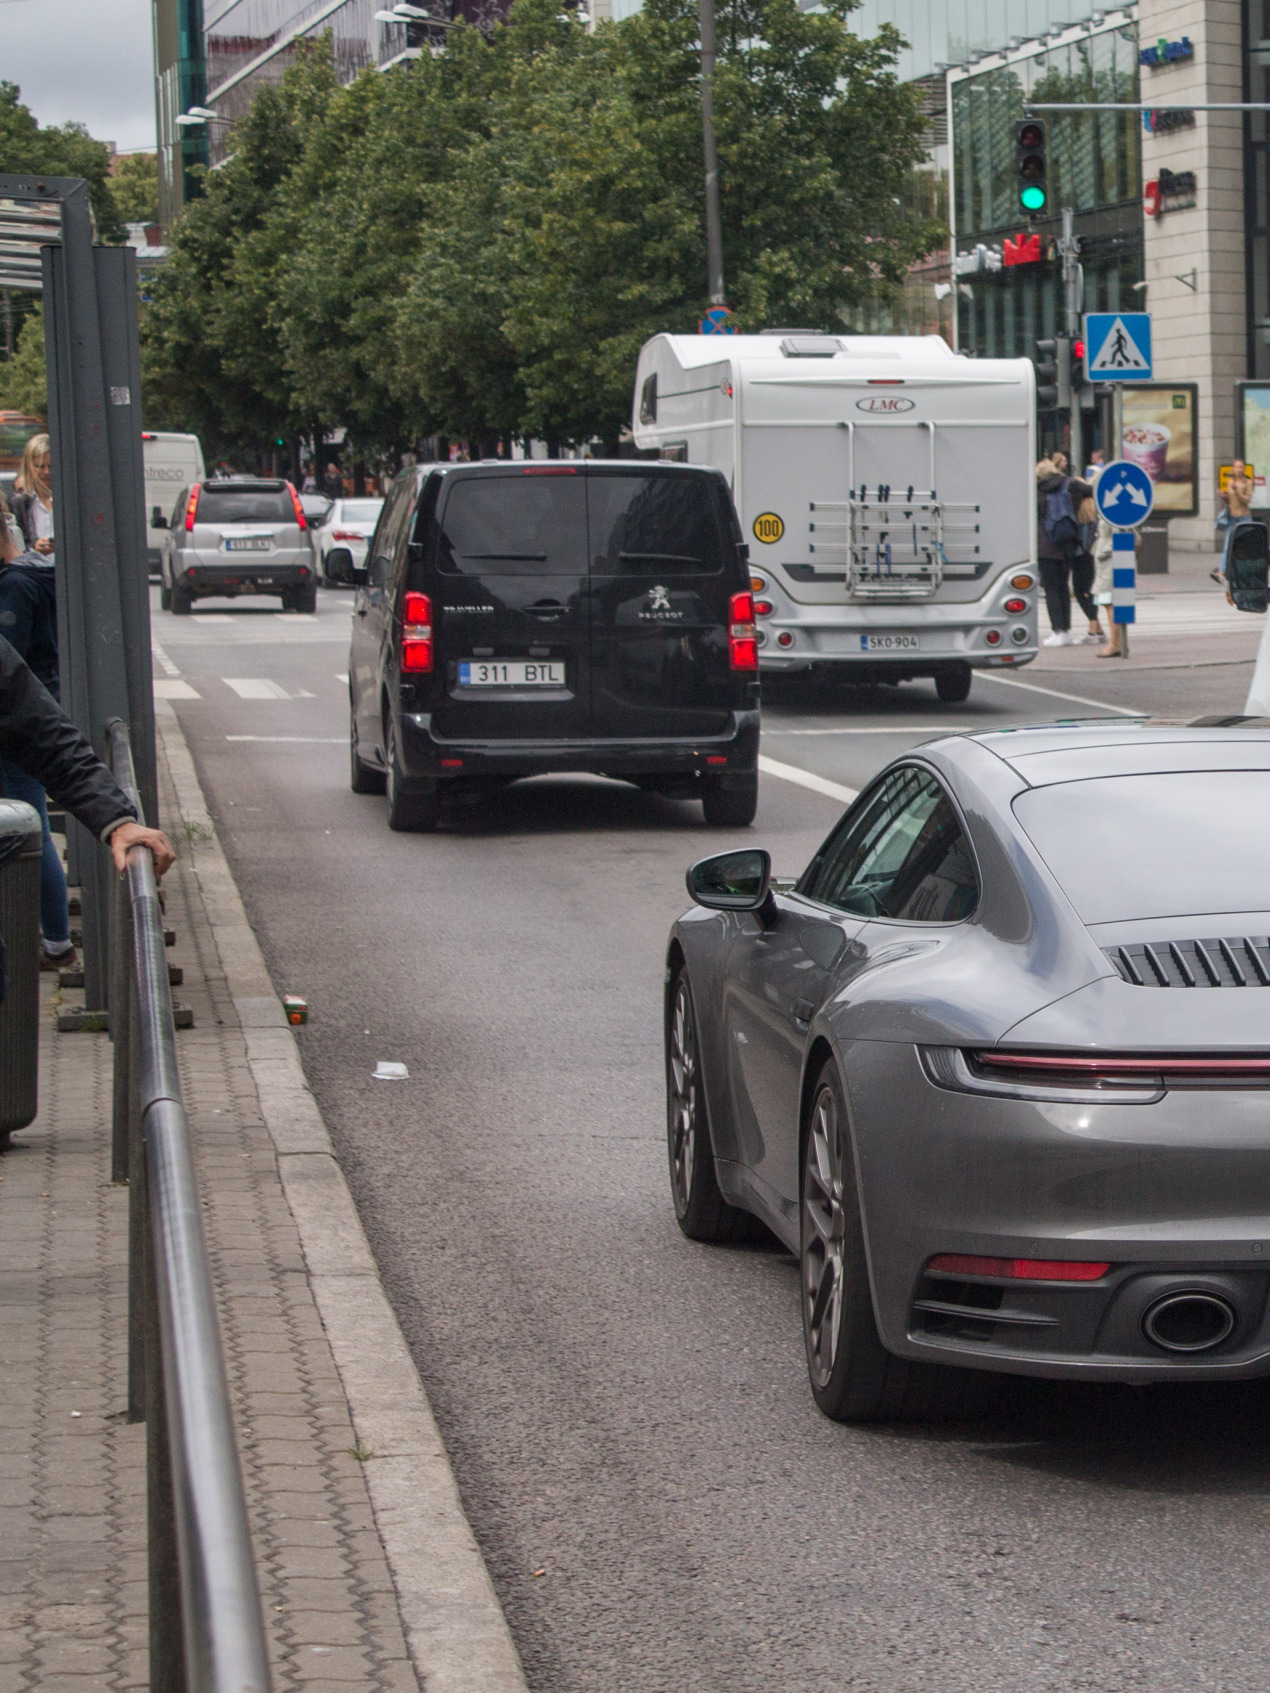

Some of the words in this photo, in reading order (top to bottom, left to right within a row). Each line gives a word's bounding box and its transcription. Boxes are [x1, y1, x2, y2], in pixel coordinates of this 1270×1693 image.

[869, 400, 905, 411] LMC
[758, 520, 780, 538] 100
[478, 665, 508, 682] 311
[525, 665, 559, 681] BTL
